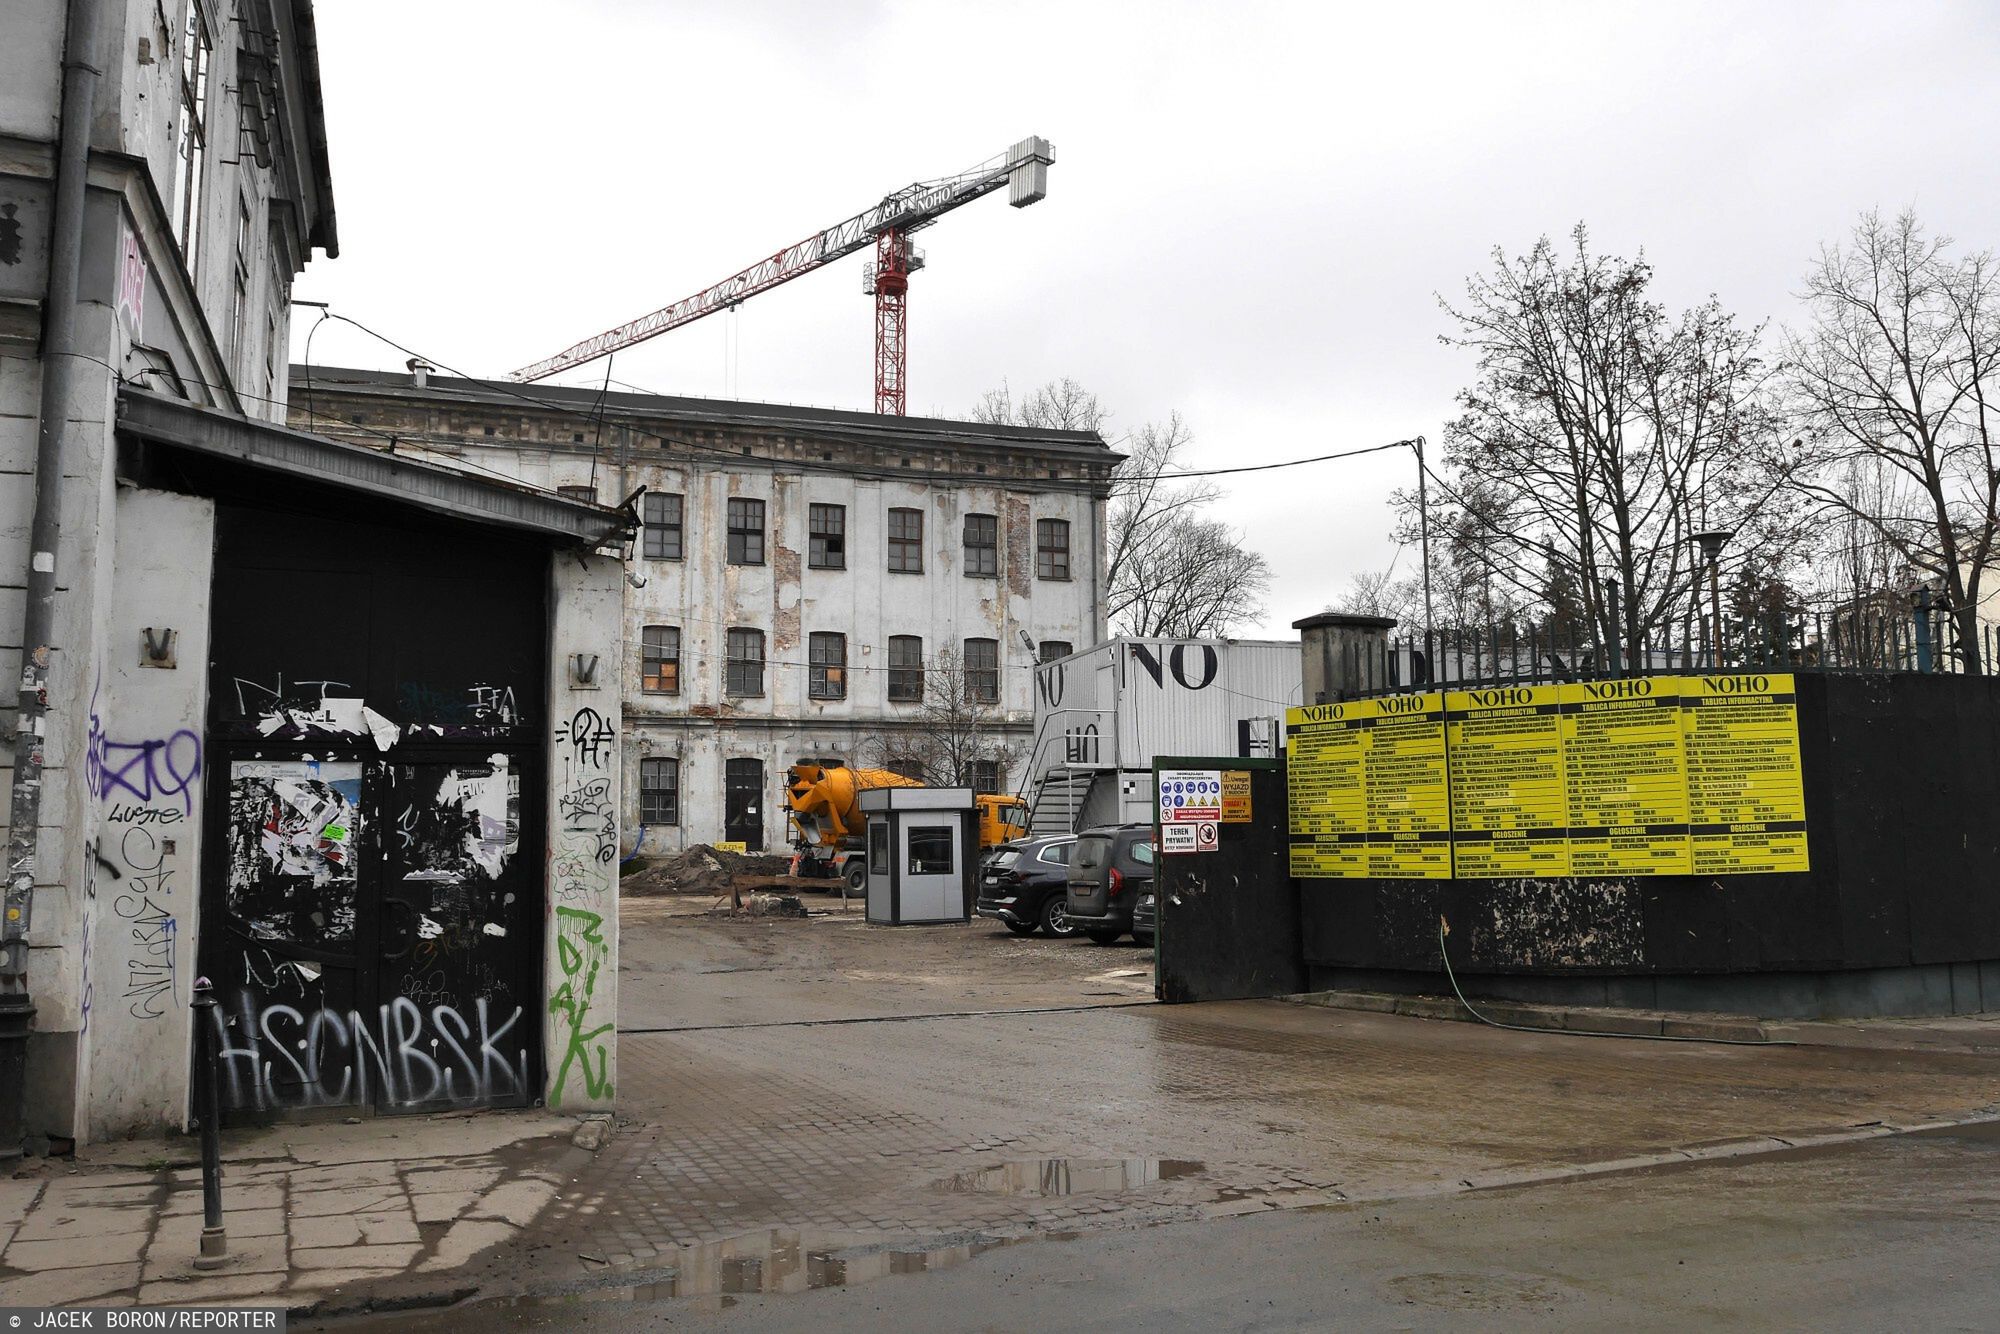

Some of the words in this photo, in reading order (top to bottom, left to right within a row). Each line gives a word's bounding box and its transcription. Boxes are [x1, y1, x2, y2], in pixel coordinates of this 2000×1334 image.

[1122, 643, 1218, 690] NO
[1584, 680, 1652, 700] NOHO
[1703, 676, 1769, 694] NOHO
[1468, 689, 1533, 708] NOHO
[1701, 697, 1727, 706] TABLICA
[1377, 696, 1424, 715] NOHO
[1582, 702, 1608, 712] TABLICA
[1301, 705, 1344, 722] NOHO
[1467, 710, 1491, 719] TABLICA
[1609, 826, 1647, 835] OGŁOSZENIE
[1730, 823, 1766, 833] OGŁOSZENIE
[1492, 830, 1527, 838] OGŁOSZENIE
[1165, 836, 1194, 844] PRYWATNY
